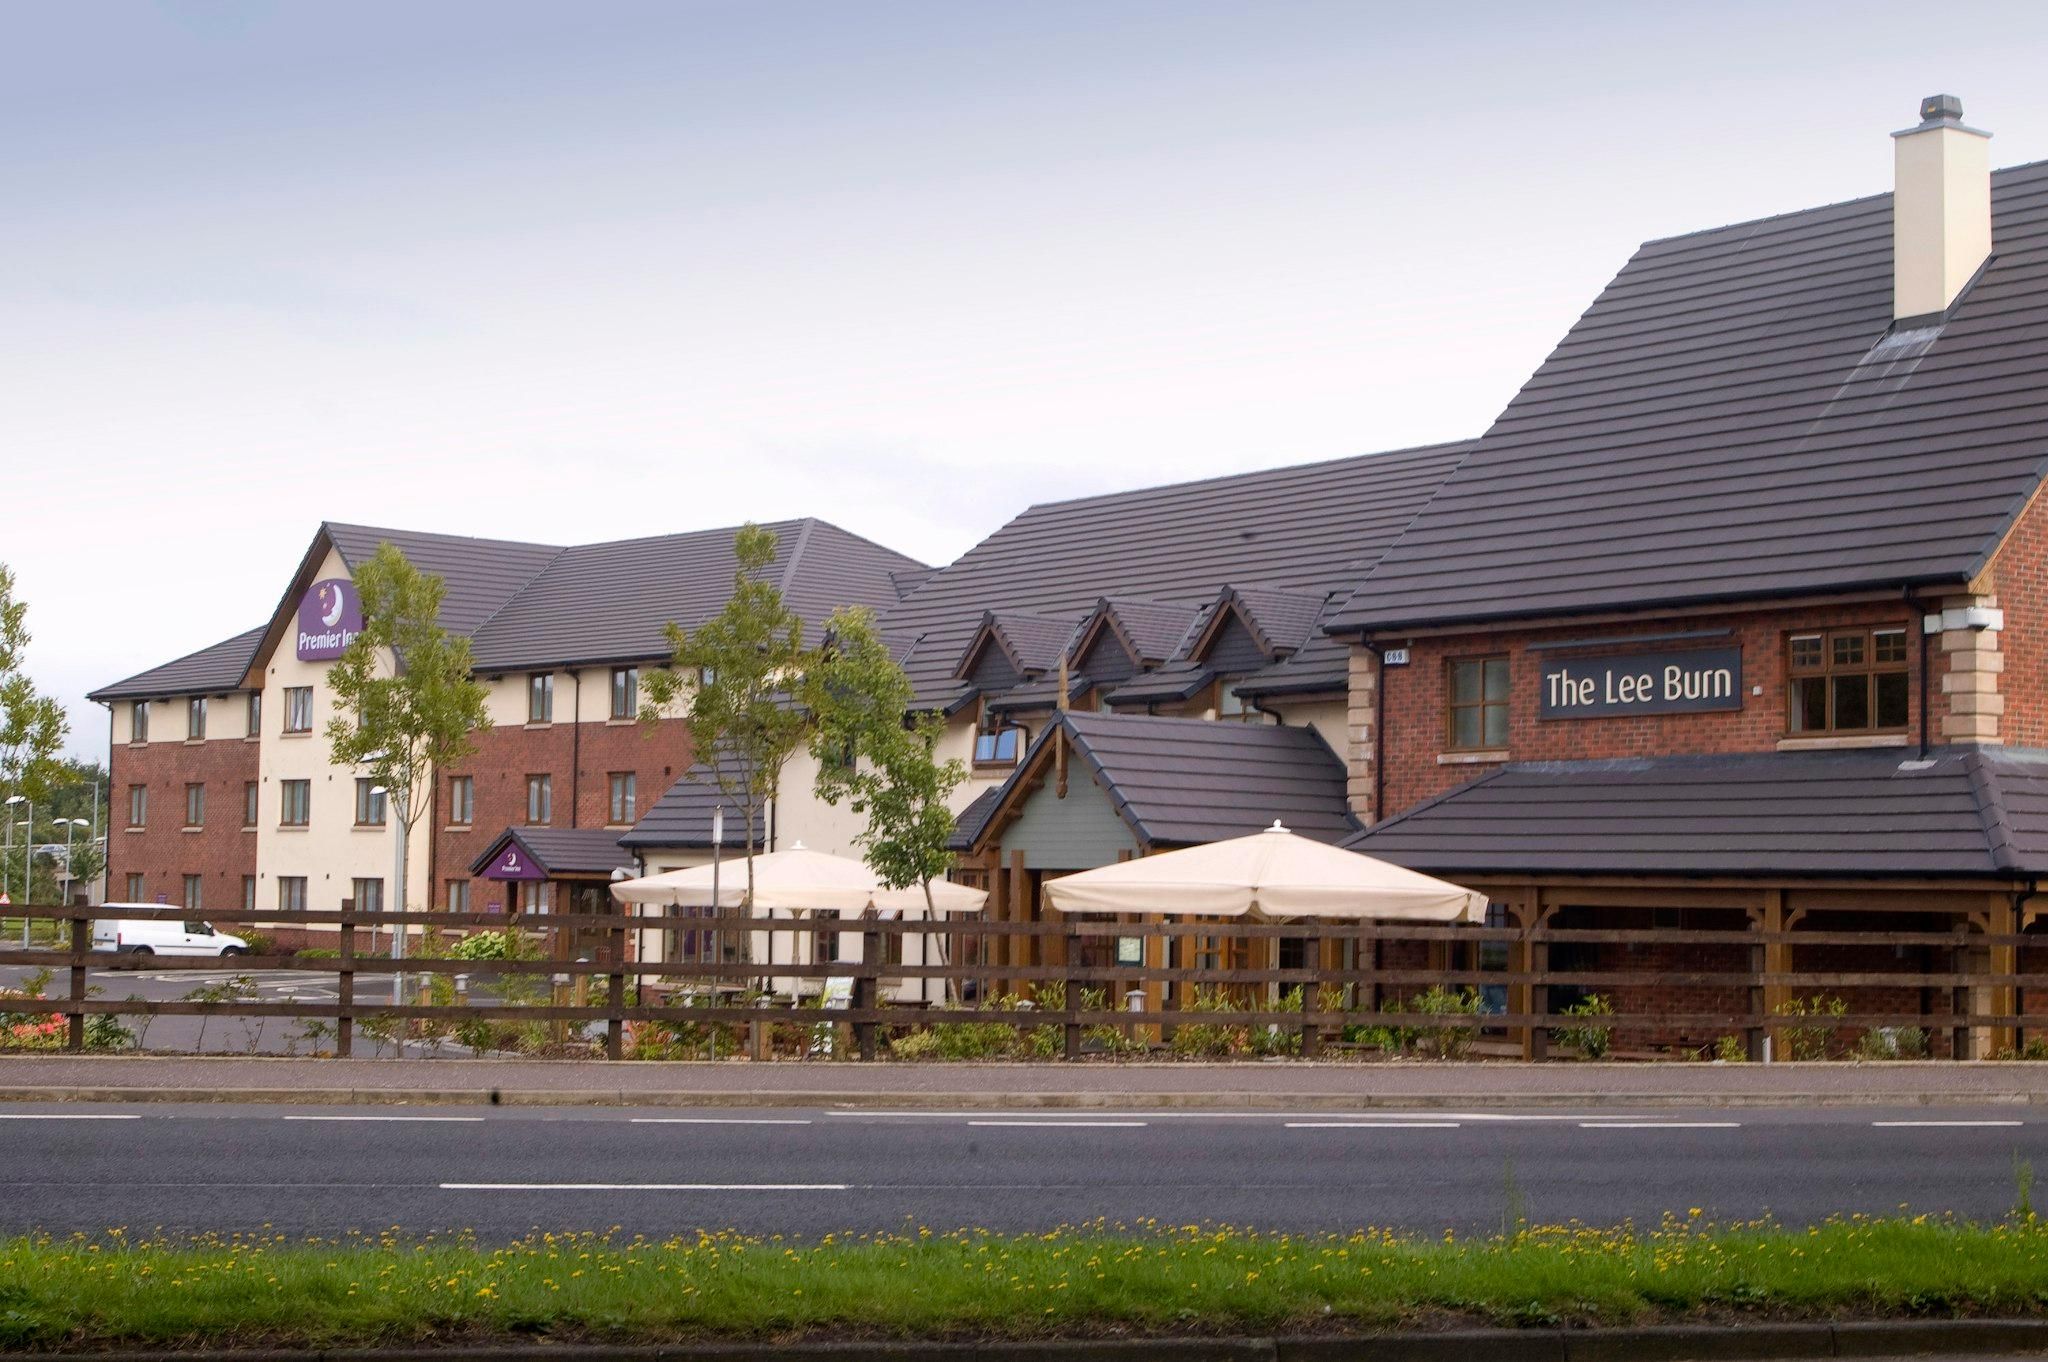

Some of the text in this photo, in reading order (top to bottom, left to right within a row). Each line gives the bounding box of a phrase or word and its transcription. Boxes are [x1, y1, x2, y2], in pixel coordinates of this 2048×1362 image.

[299, 630, 341, 650] Premier
[1547, 665, 1731, 707] The Lee Burn
